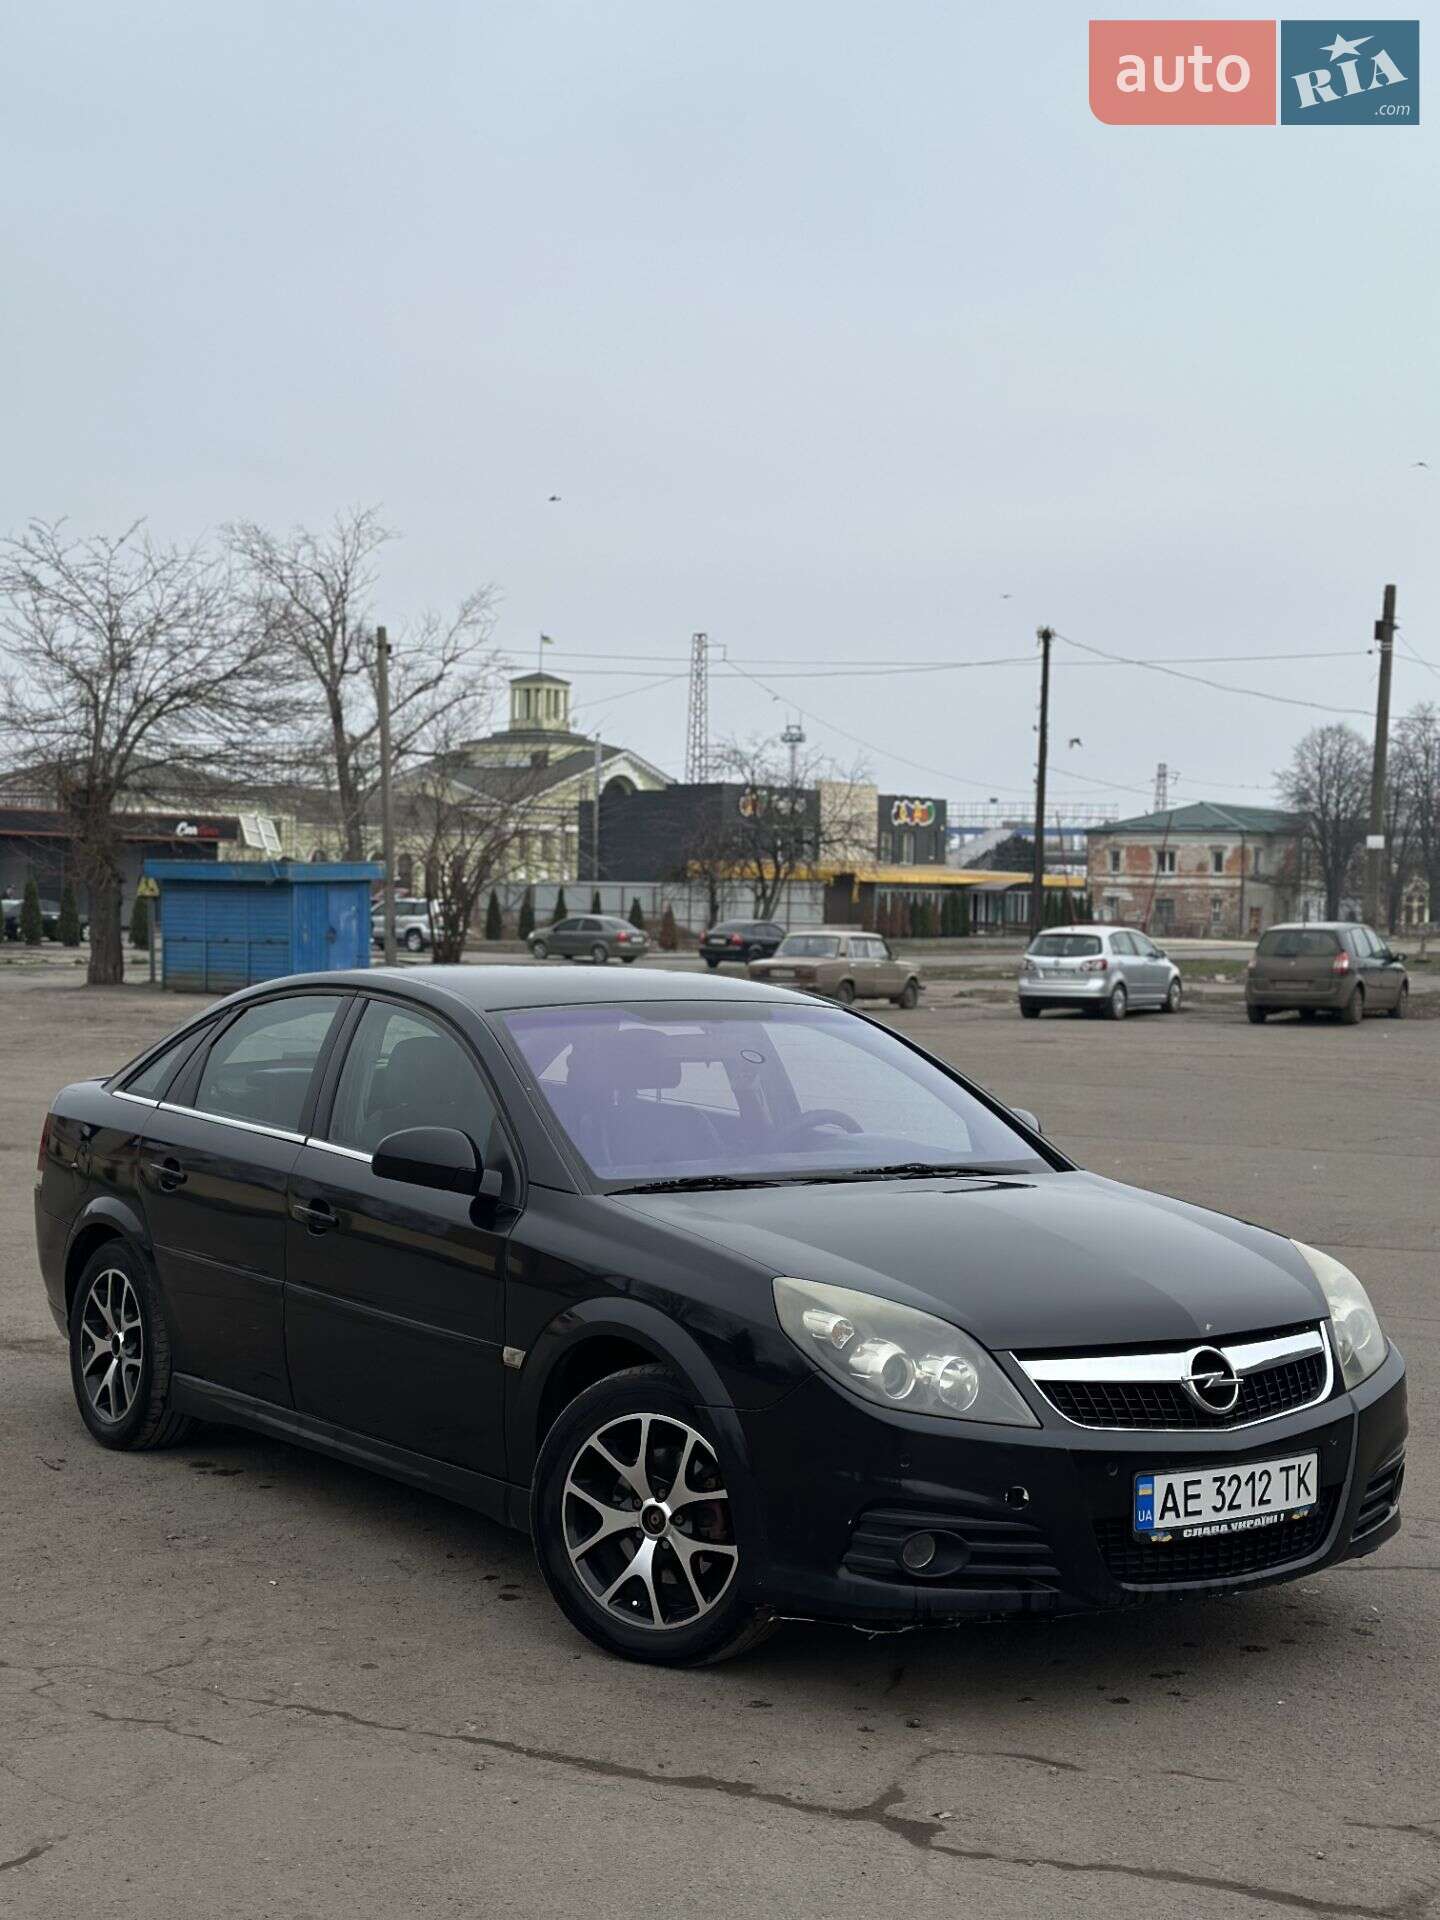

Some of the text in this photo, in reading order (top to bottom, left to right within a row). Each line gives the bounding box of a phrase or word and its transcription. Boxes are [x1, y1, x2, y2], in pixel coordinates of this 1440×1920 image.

[1158, 1461, 1313, 1521] AE 3212 TK
[1138, 1510, 1153, 1522] UA
[1183, 1524, 1229, 1538] СЛАВА
